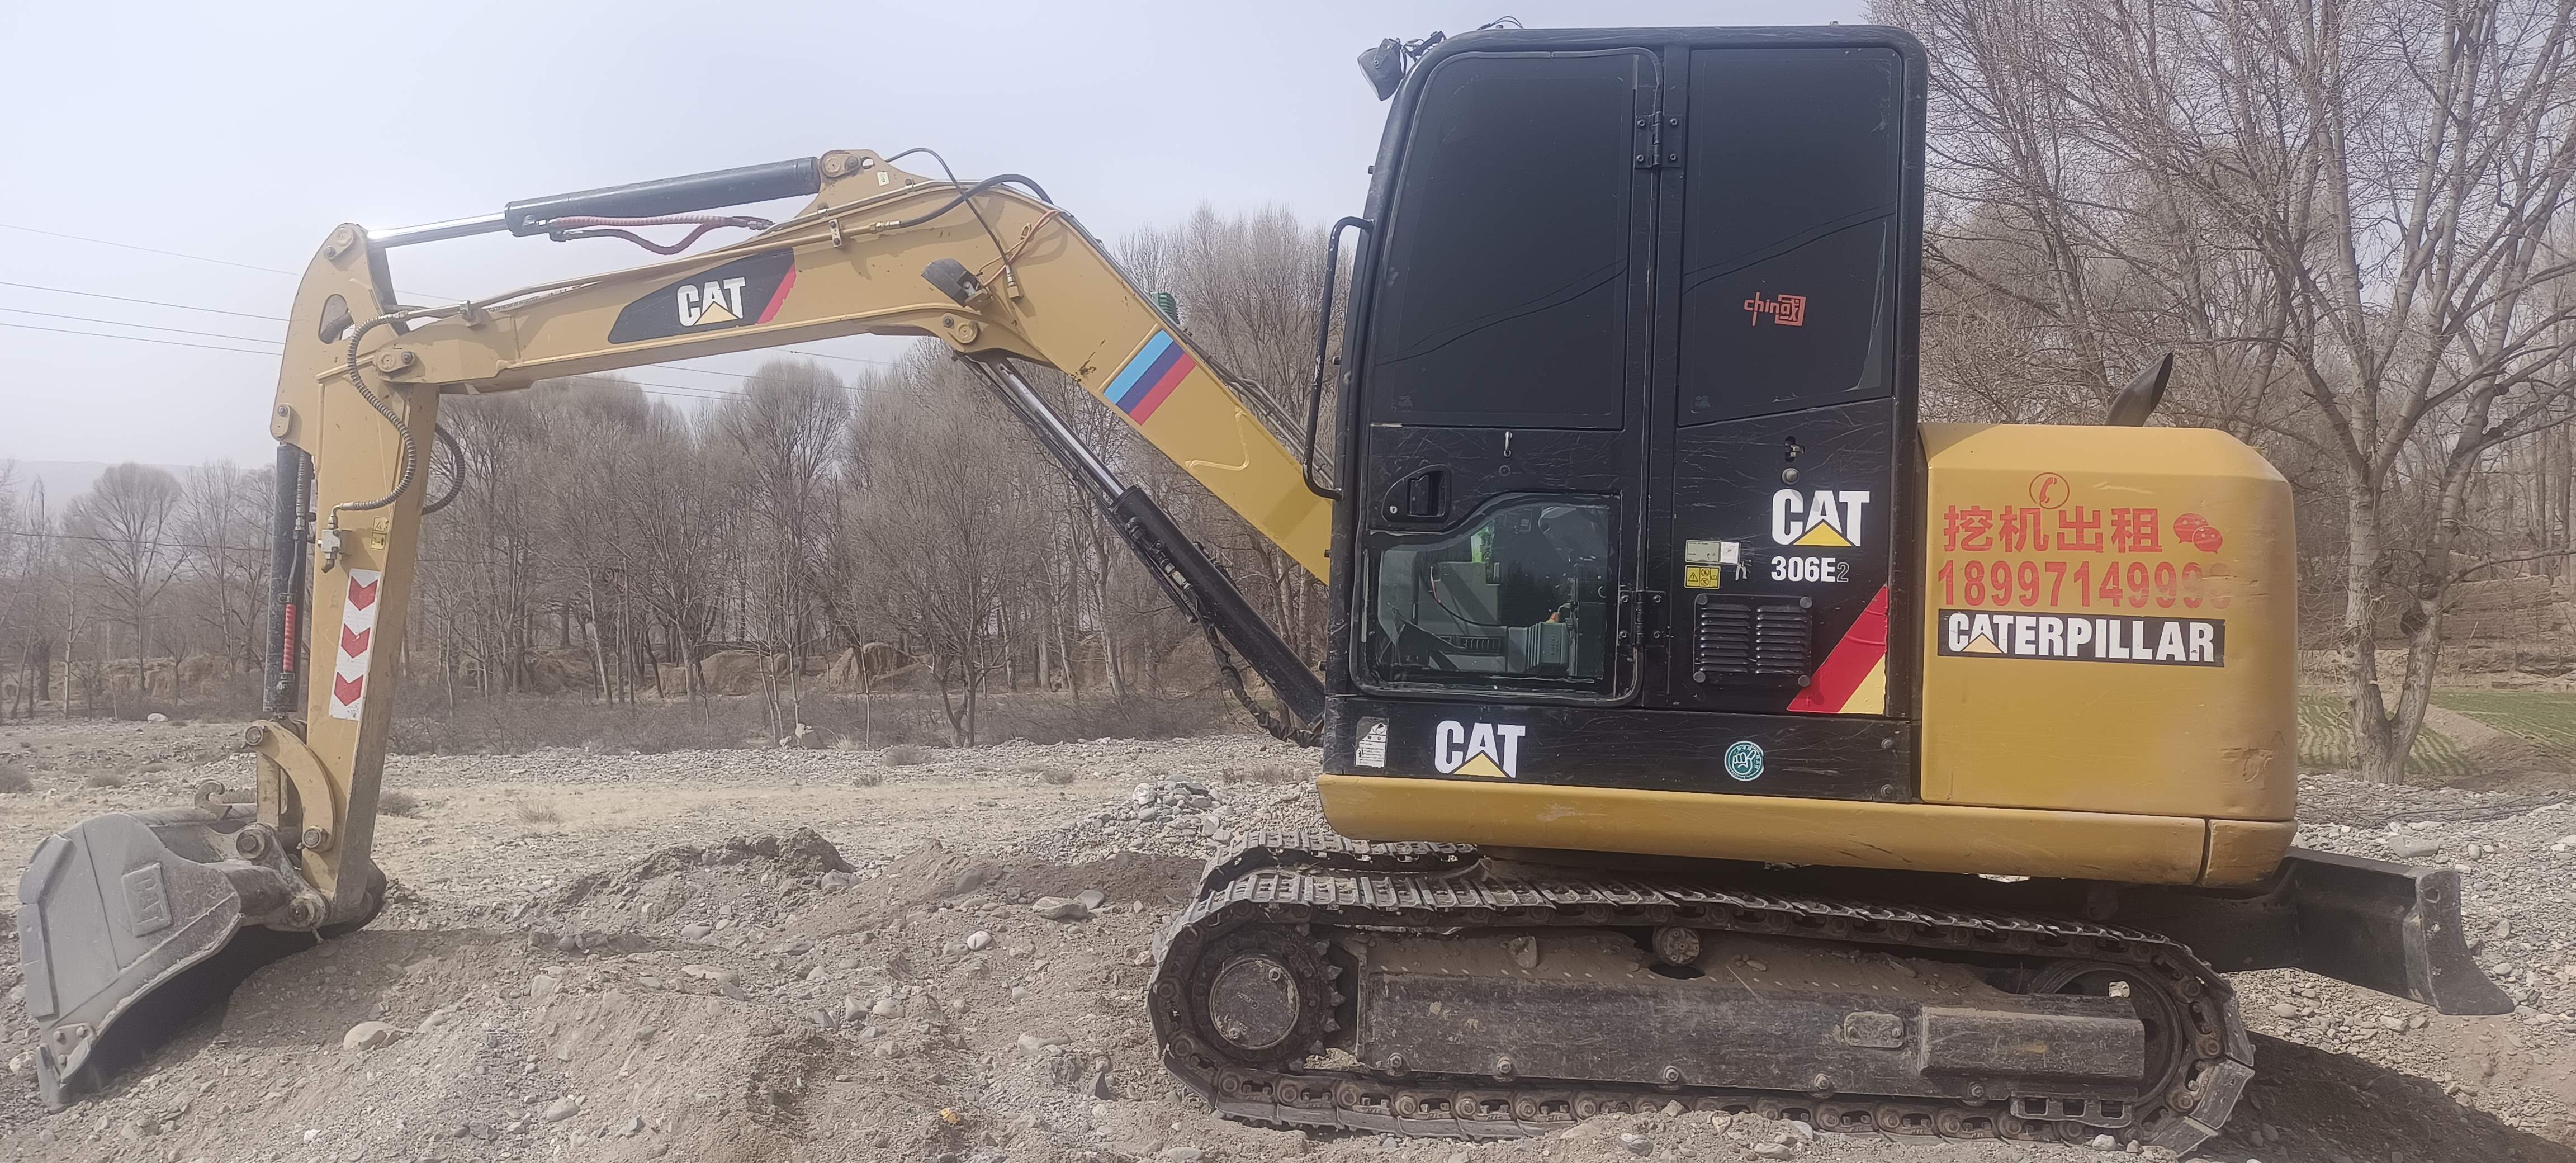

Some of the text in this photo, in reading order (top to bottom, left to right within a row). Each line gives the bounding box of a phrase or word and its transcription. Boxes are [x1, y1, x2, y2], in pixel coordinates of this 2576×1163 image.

[677, 277, 746, 327] CAT
[1772, 489, 1870, 546] CAT
[1943, 505, 2162, 553] 挖机出租
[1771, 556, 1849, 582] 306E2
[1938, 560, 2231, 609] 1899714999
[1948, 613, 2214, 663] CATERPILLAR
[1434, 720, 1526, 778] CAT
